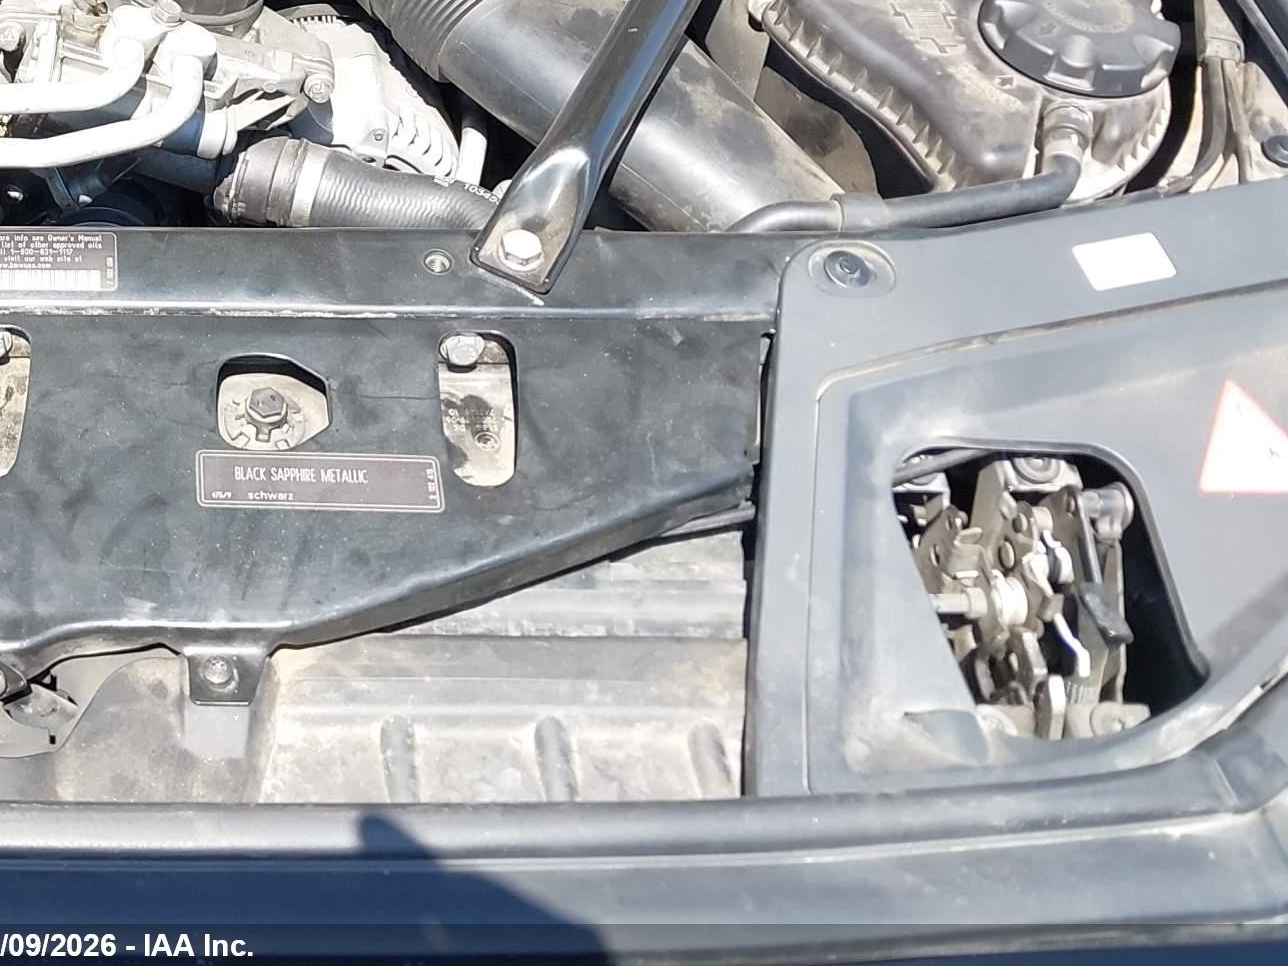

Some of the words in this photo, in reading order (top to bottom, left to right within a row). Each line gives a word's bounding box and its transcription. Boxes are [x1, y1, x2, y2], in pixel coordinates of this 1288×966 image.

[14, 234, 28, 242] info
[78, 234, 102, 242] Manual
[53, 241, 84, 250] approved
[87, 241, 102, 249] oils
[234, 465, 267, 481] BLACK
[270, 467, 316, 482] SAPPHIRE
[319, 468, 369, 483] METALLIC
[247, 490, 294, 501] schwarz
